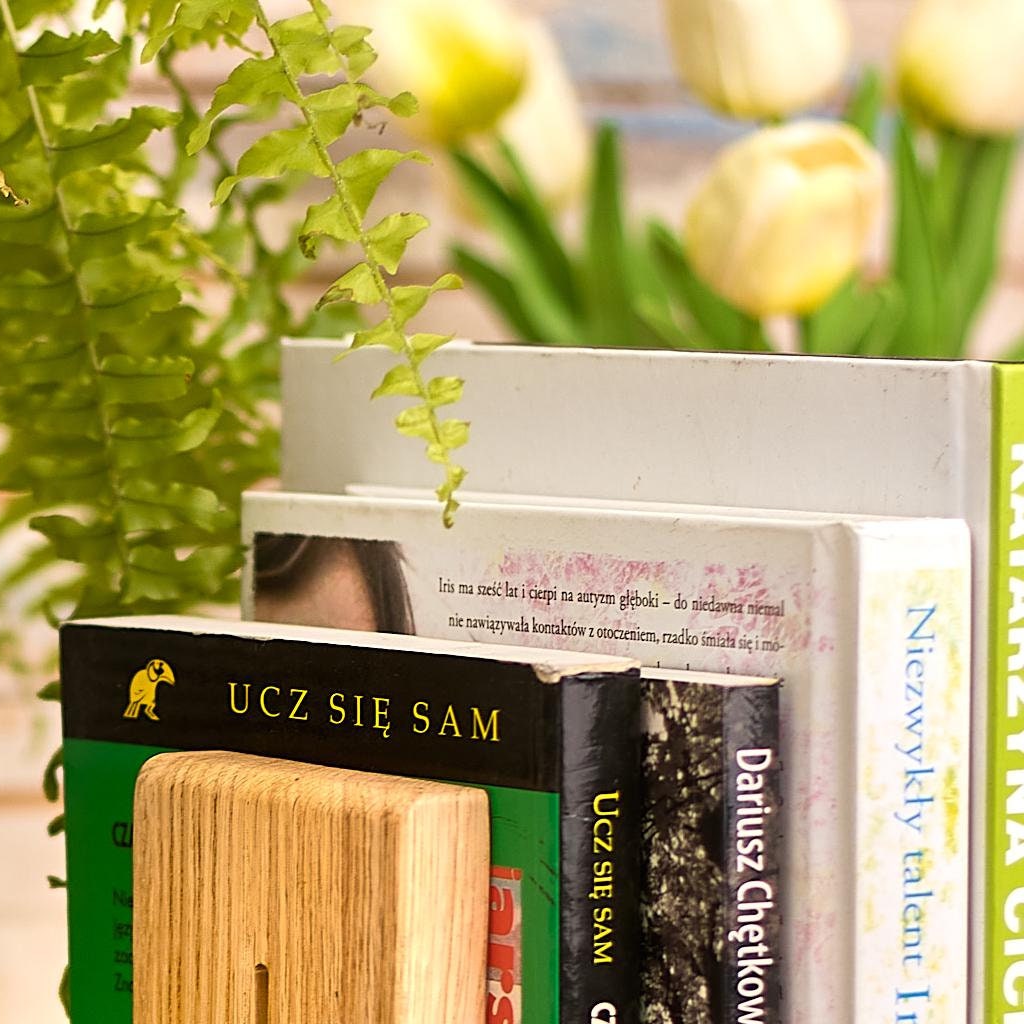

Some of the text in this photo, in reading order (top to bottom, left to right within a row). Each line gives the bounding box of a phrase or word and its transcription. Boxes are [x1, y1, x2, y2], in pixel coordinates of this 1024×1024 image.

[439, 577, 455, 593] Iris
[458, 584, 474, 595] ma
[477, 581, 503, 597] sześć
[505, 581, 518, 598] lat
[521, 584, 526, 599] i
[528, 586, 557, 606] cierpi
[561, 590, 574, 602] na
[577, 591, 616, 608] autyzm
[619, 589, 659, 611] głęboki
[674, 592, 688, 610] do
[692, 595, 744, 614] niedawna
[747, 599, 785, 617] niemal
[448, 612, 464, 628] nie
[466, 614, 529, 636] nawiązywała
[532, 616, 587, 637] kontaktów
[588, 626, 595, 638] z
[596, 626, 660, 645] otoczeniem,
[662, 628, 699, 646] rzadko
[701, 631, 736, 649] śmiała
[738, 634, 753, 654] się
[227, 682, 501, 742] UCZ SIĘ SAM
[894, 602, 938, 832] Niezwykły
[736, 748, 772, 873] Dariusz
[587, 861, 614, 899] SIĘ
[901, 850, 934, 967] talent
[593, 907, 614, 964] SAM
